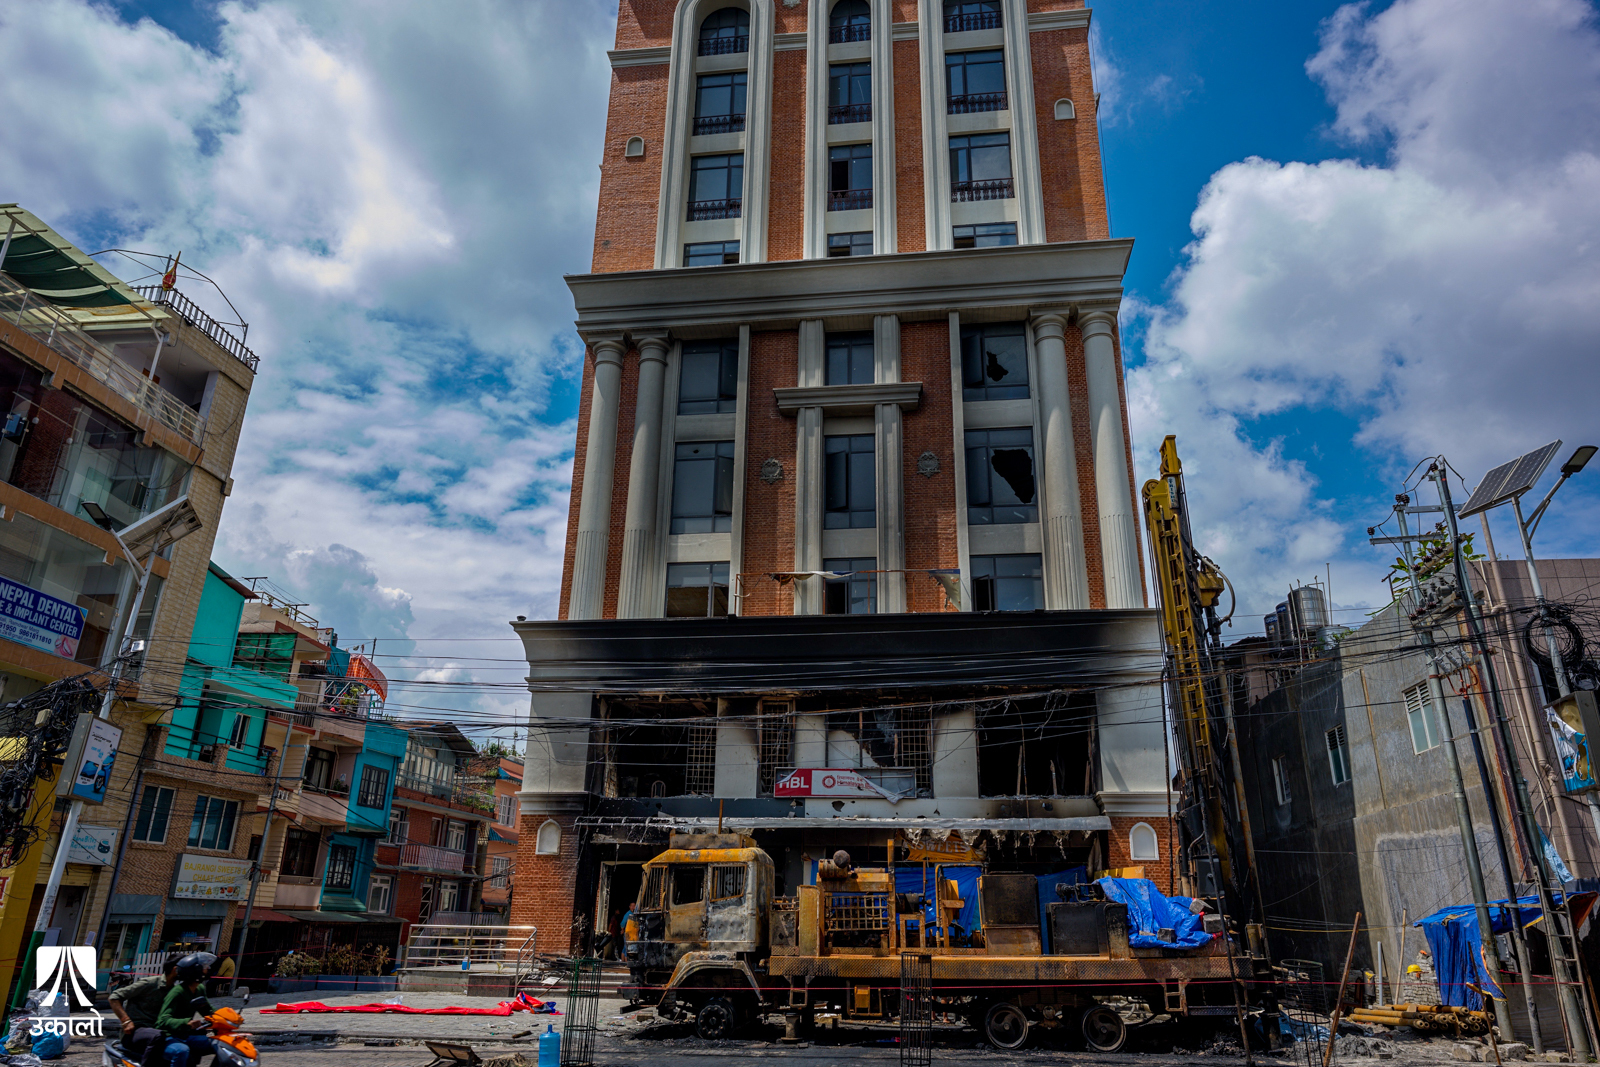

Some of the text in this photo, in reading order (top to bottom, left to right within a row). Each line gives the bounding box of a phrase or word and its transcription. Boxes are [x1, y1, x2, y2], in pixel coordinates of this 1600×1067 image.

[0, 582, 77, 624] NEPAL DENTAL
[5, 603, 12, 614] &
[13, 606, 50, 627] IMPLANT
[50, 619, 78, 637] CENTER
[184, 862, 216, 872] BAJRANGI
[217, 866, 241, 874] SWEETS
[215, 876, 236, 884] HOUSE
